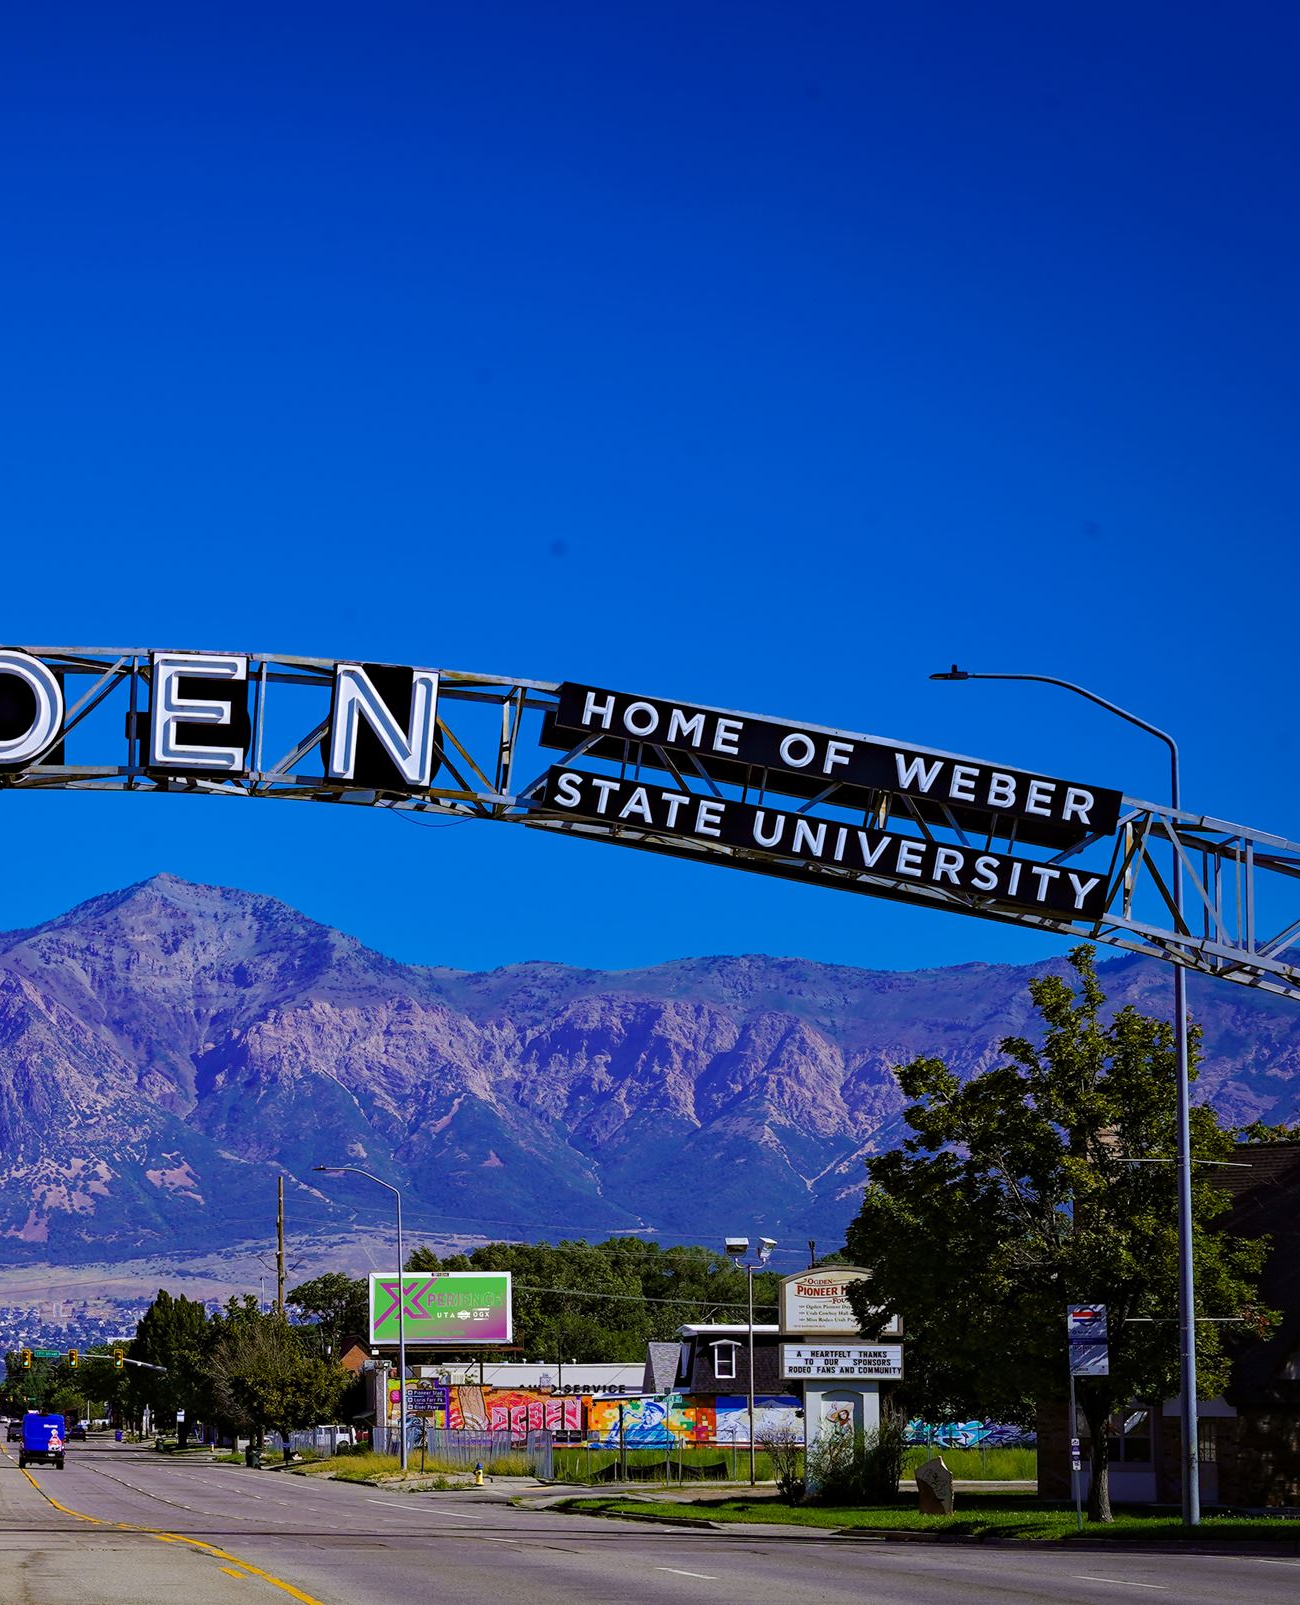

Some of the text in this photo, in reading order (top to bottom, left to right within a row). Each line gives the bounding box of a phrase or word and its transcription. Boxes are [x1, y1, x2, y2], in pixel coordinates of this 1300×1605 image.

[581, 691, 1095, 825] HOME OF WEBER
[554, 772, 1101, 910] STATE UNIVERSITY
[797, 1285, 838, 1296] PIONEER
[804, 1358, 814, 1366] TO
[817, 1366, 836, 1374] FANS
[840, 1366, 854, 1374] AND
[858, 1366, 902, 1374] COMMUNITY
[563, 1384, 626, 1394] SERVICE
